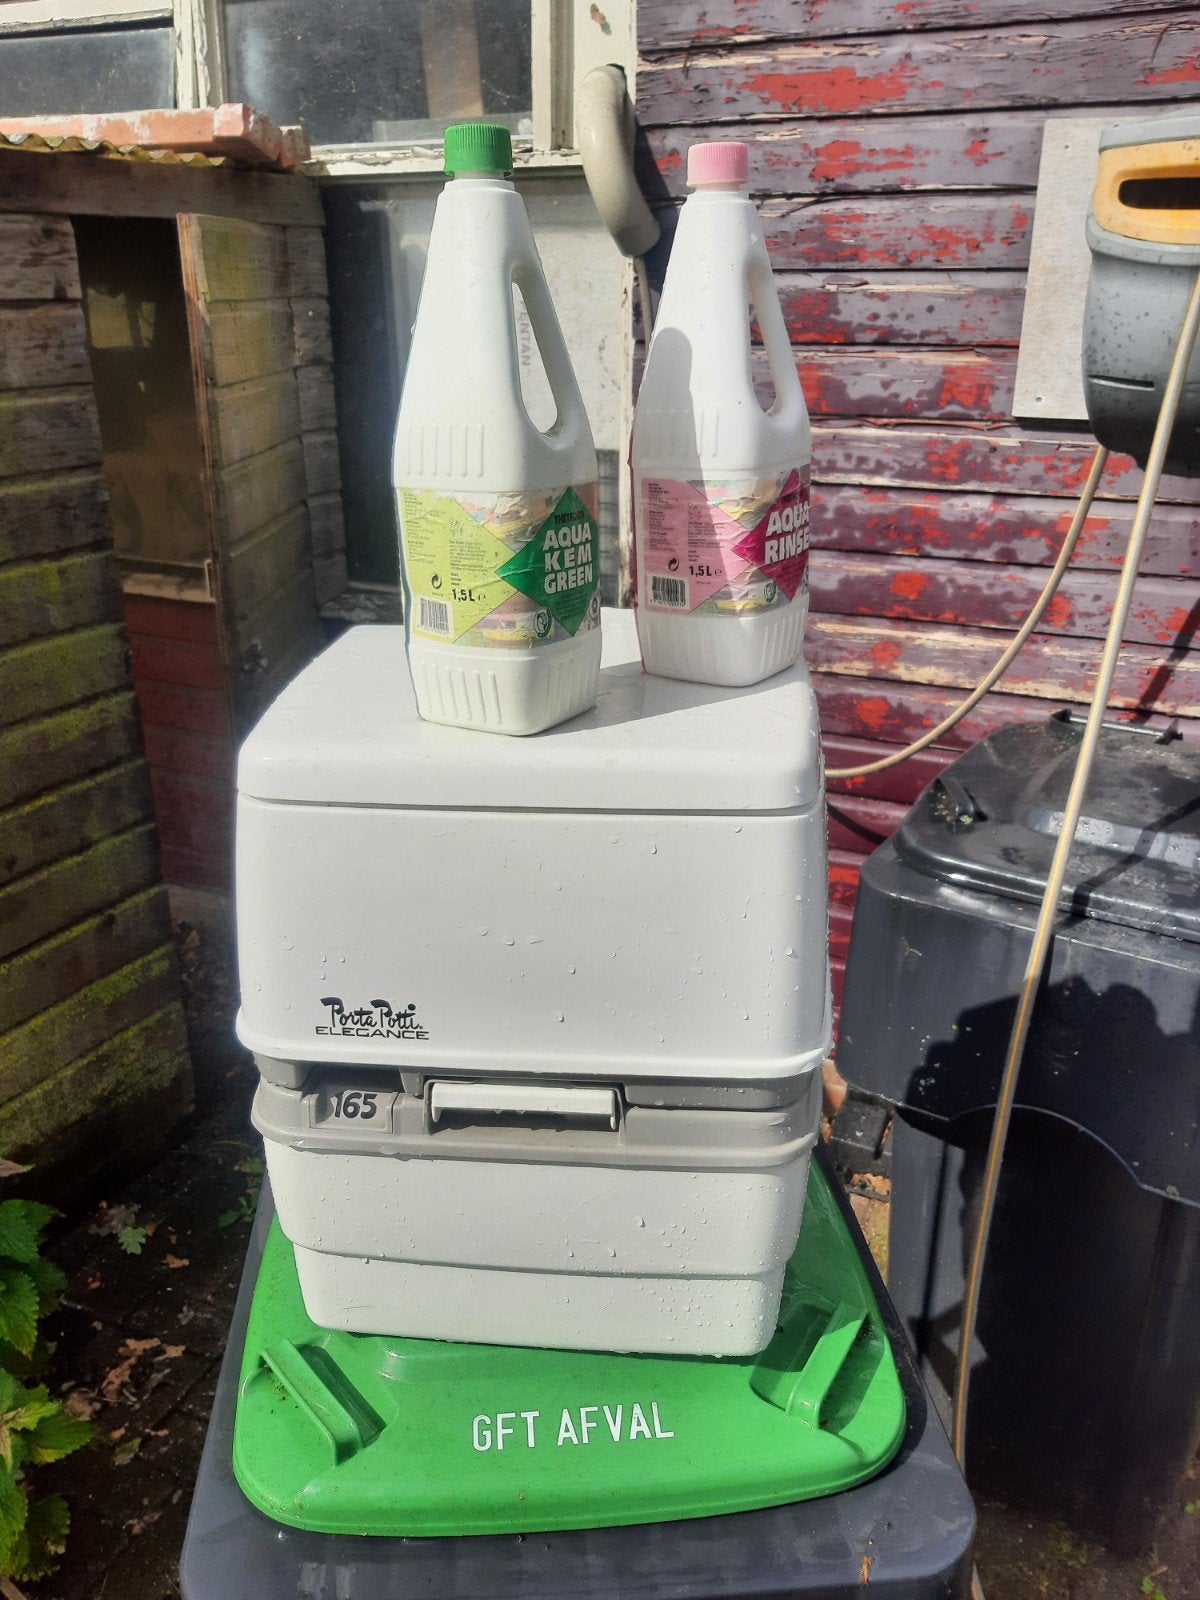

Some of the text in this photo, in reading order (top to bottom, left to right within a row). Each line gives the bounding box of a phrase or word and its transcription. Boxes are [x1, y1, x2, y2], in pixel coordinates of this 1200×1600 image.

[765, 500, 810, 537] AQUA
[543, 522, 592, 551] AQUA
[764, 527, 810, 565] RINSE
[545, 543, 592, 572] KEM
[544, 567, 594, 595] GREEN
[320, 997, 377, 1028] Porta
[315, 1026, 429, 1040] ELEGANCE
[334, 1092, 377, 1119] 165
[472, 1402, 675, 1451] GFT AFVAL
